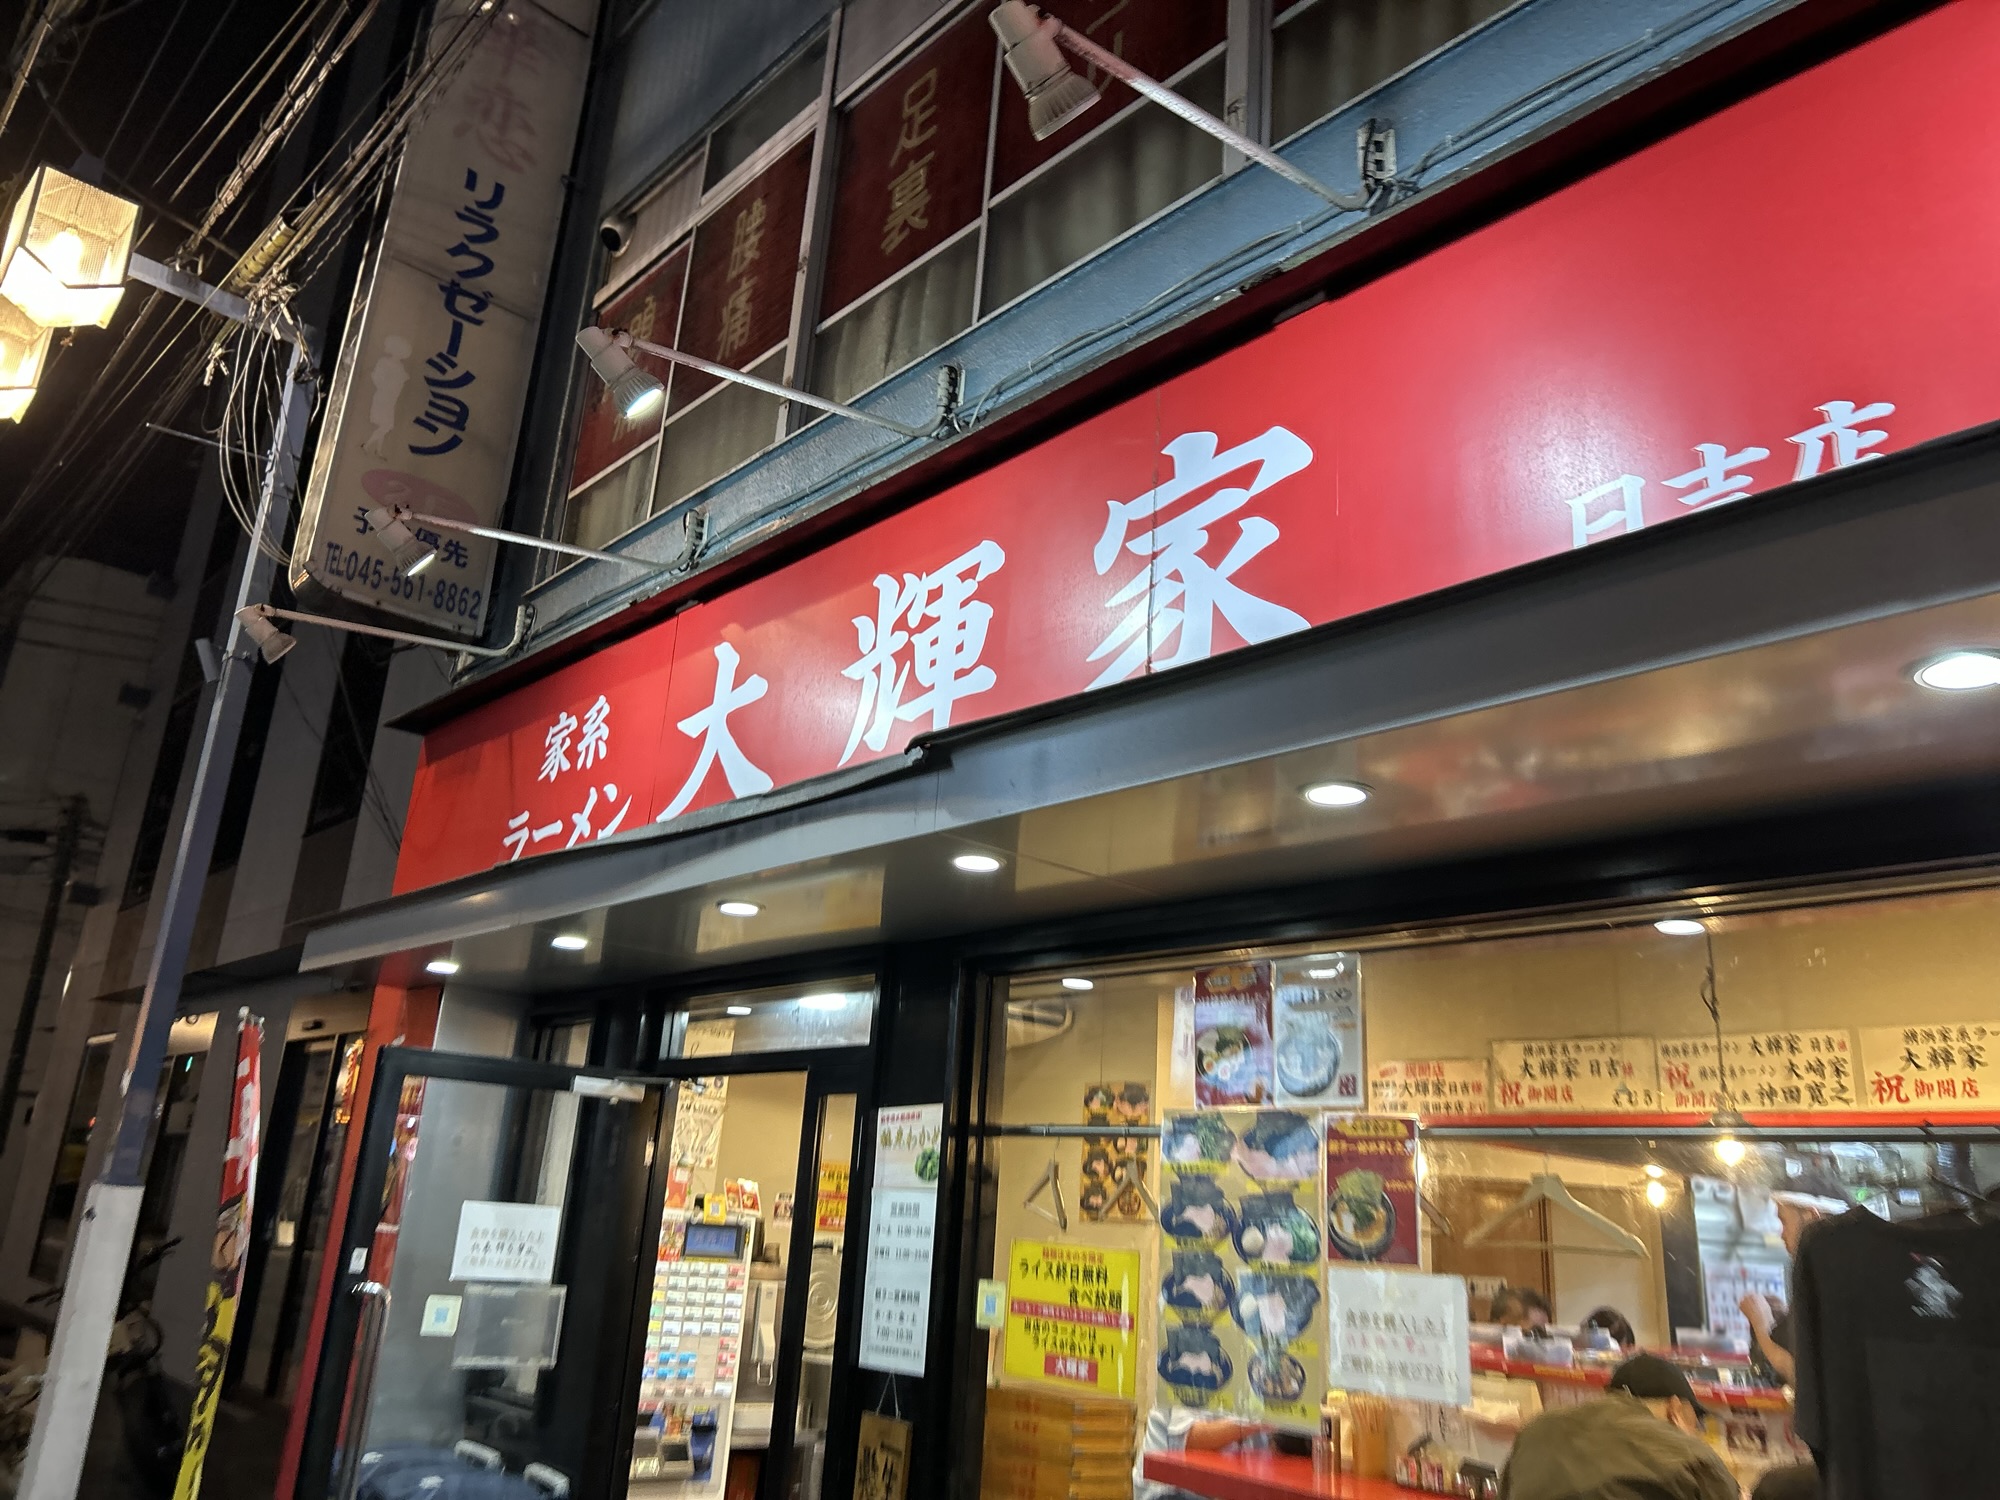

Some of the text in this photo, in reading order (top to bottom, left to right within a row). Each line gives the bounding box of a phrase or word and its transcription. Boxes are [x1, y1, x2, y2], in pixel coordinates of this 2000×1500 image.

[881, 66, 938, 256] 足裏
[715, 202, 768, 359] 腰痛
[408, 167, 507, 457] リラクゼーション
[656, 425, 1314, 823] 大輝家
[537, 694, 611, 783] 家系
[502, 782, 633, 863] ラーメン
[1748, 1032, 1804, 1057] 大輝家
[1898, 1042, 1989, 1073] 大輝家
[1662, 1058, 1696, 1091] 祝
[1870, 1070, 1981, 1105] 祝 御開店
[1497, 1077, 1526, 1107] 祝
[1019, 1257, 1109, 1289] ライス終日無料
[1068, 1285, 1124, 1312] 食べ放題
[1024, 1316, 1098, 1344] 当店のラーメンは
